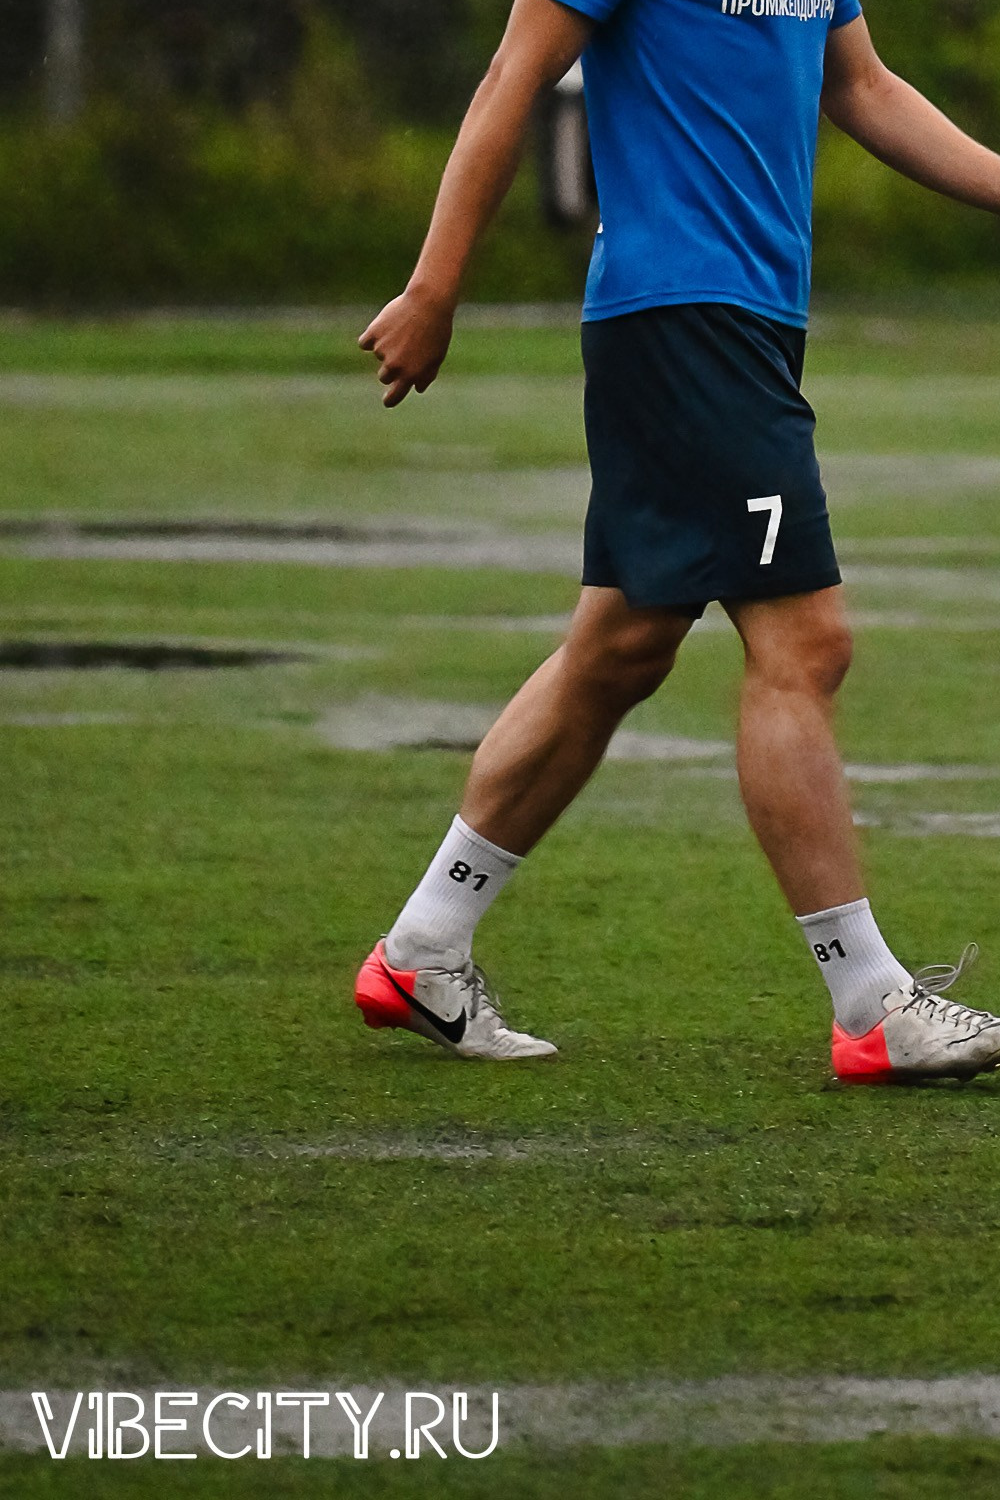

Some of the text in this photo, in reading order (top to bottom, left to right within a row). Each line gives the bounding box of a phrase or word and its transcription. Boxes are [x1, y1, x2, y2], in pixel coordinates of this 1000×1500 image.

[746, 494, 783, 565] 7
[449, 860, 489, 892] 81
[813, 938, 846, 963] 81
